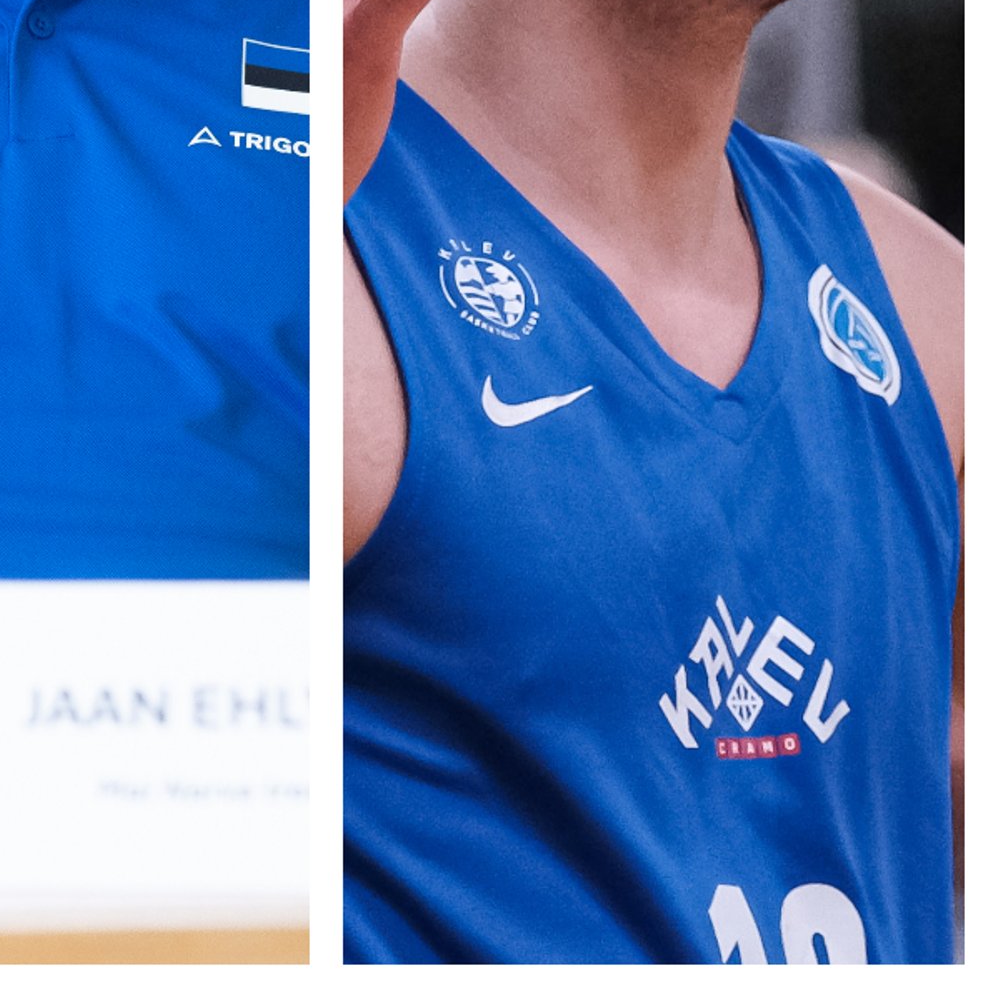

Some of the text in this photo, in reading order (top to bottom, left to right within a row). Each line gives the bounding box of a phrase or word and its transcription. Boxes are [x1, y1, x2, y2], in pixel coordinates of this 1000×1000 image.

[658, 594, 851, 749] KALEV
[27, 686, 310, 730] JAAN EHL
[717, 736, 797, 755] CRAMO
